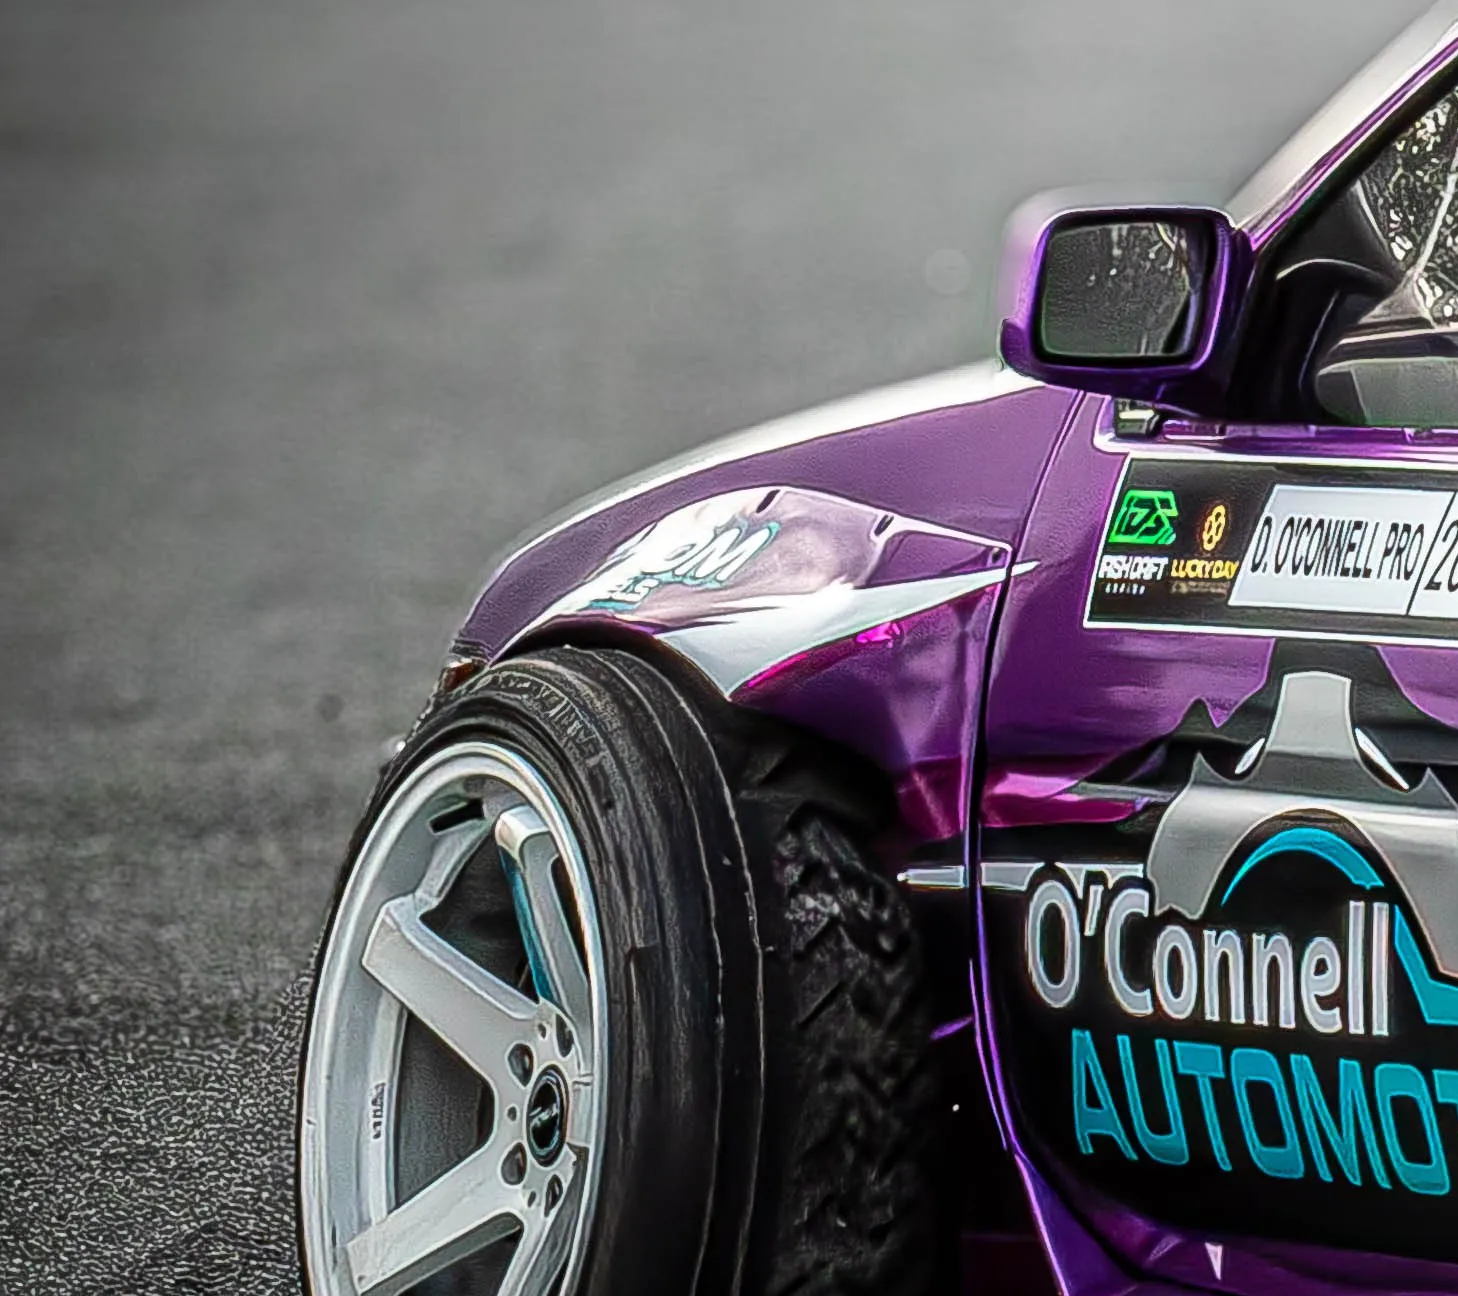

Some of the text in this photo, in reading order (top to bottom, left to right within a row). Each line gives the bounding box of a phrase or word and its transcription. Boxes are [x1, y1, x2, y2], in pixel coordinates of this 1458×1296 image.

[1250, 515, 1273, 574] D.
[1274, 515, 1380, 579] O'CONNELL
[1377, 520, 1425, 581] PRO
[1024, 878, 1390, 1037] O'Connell
